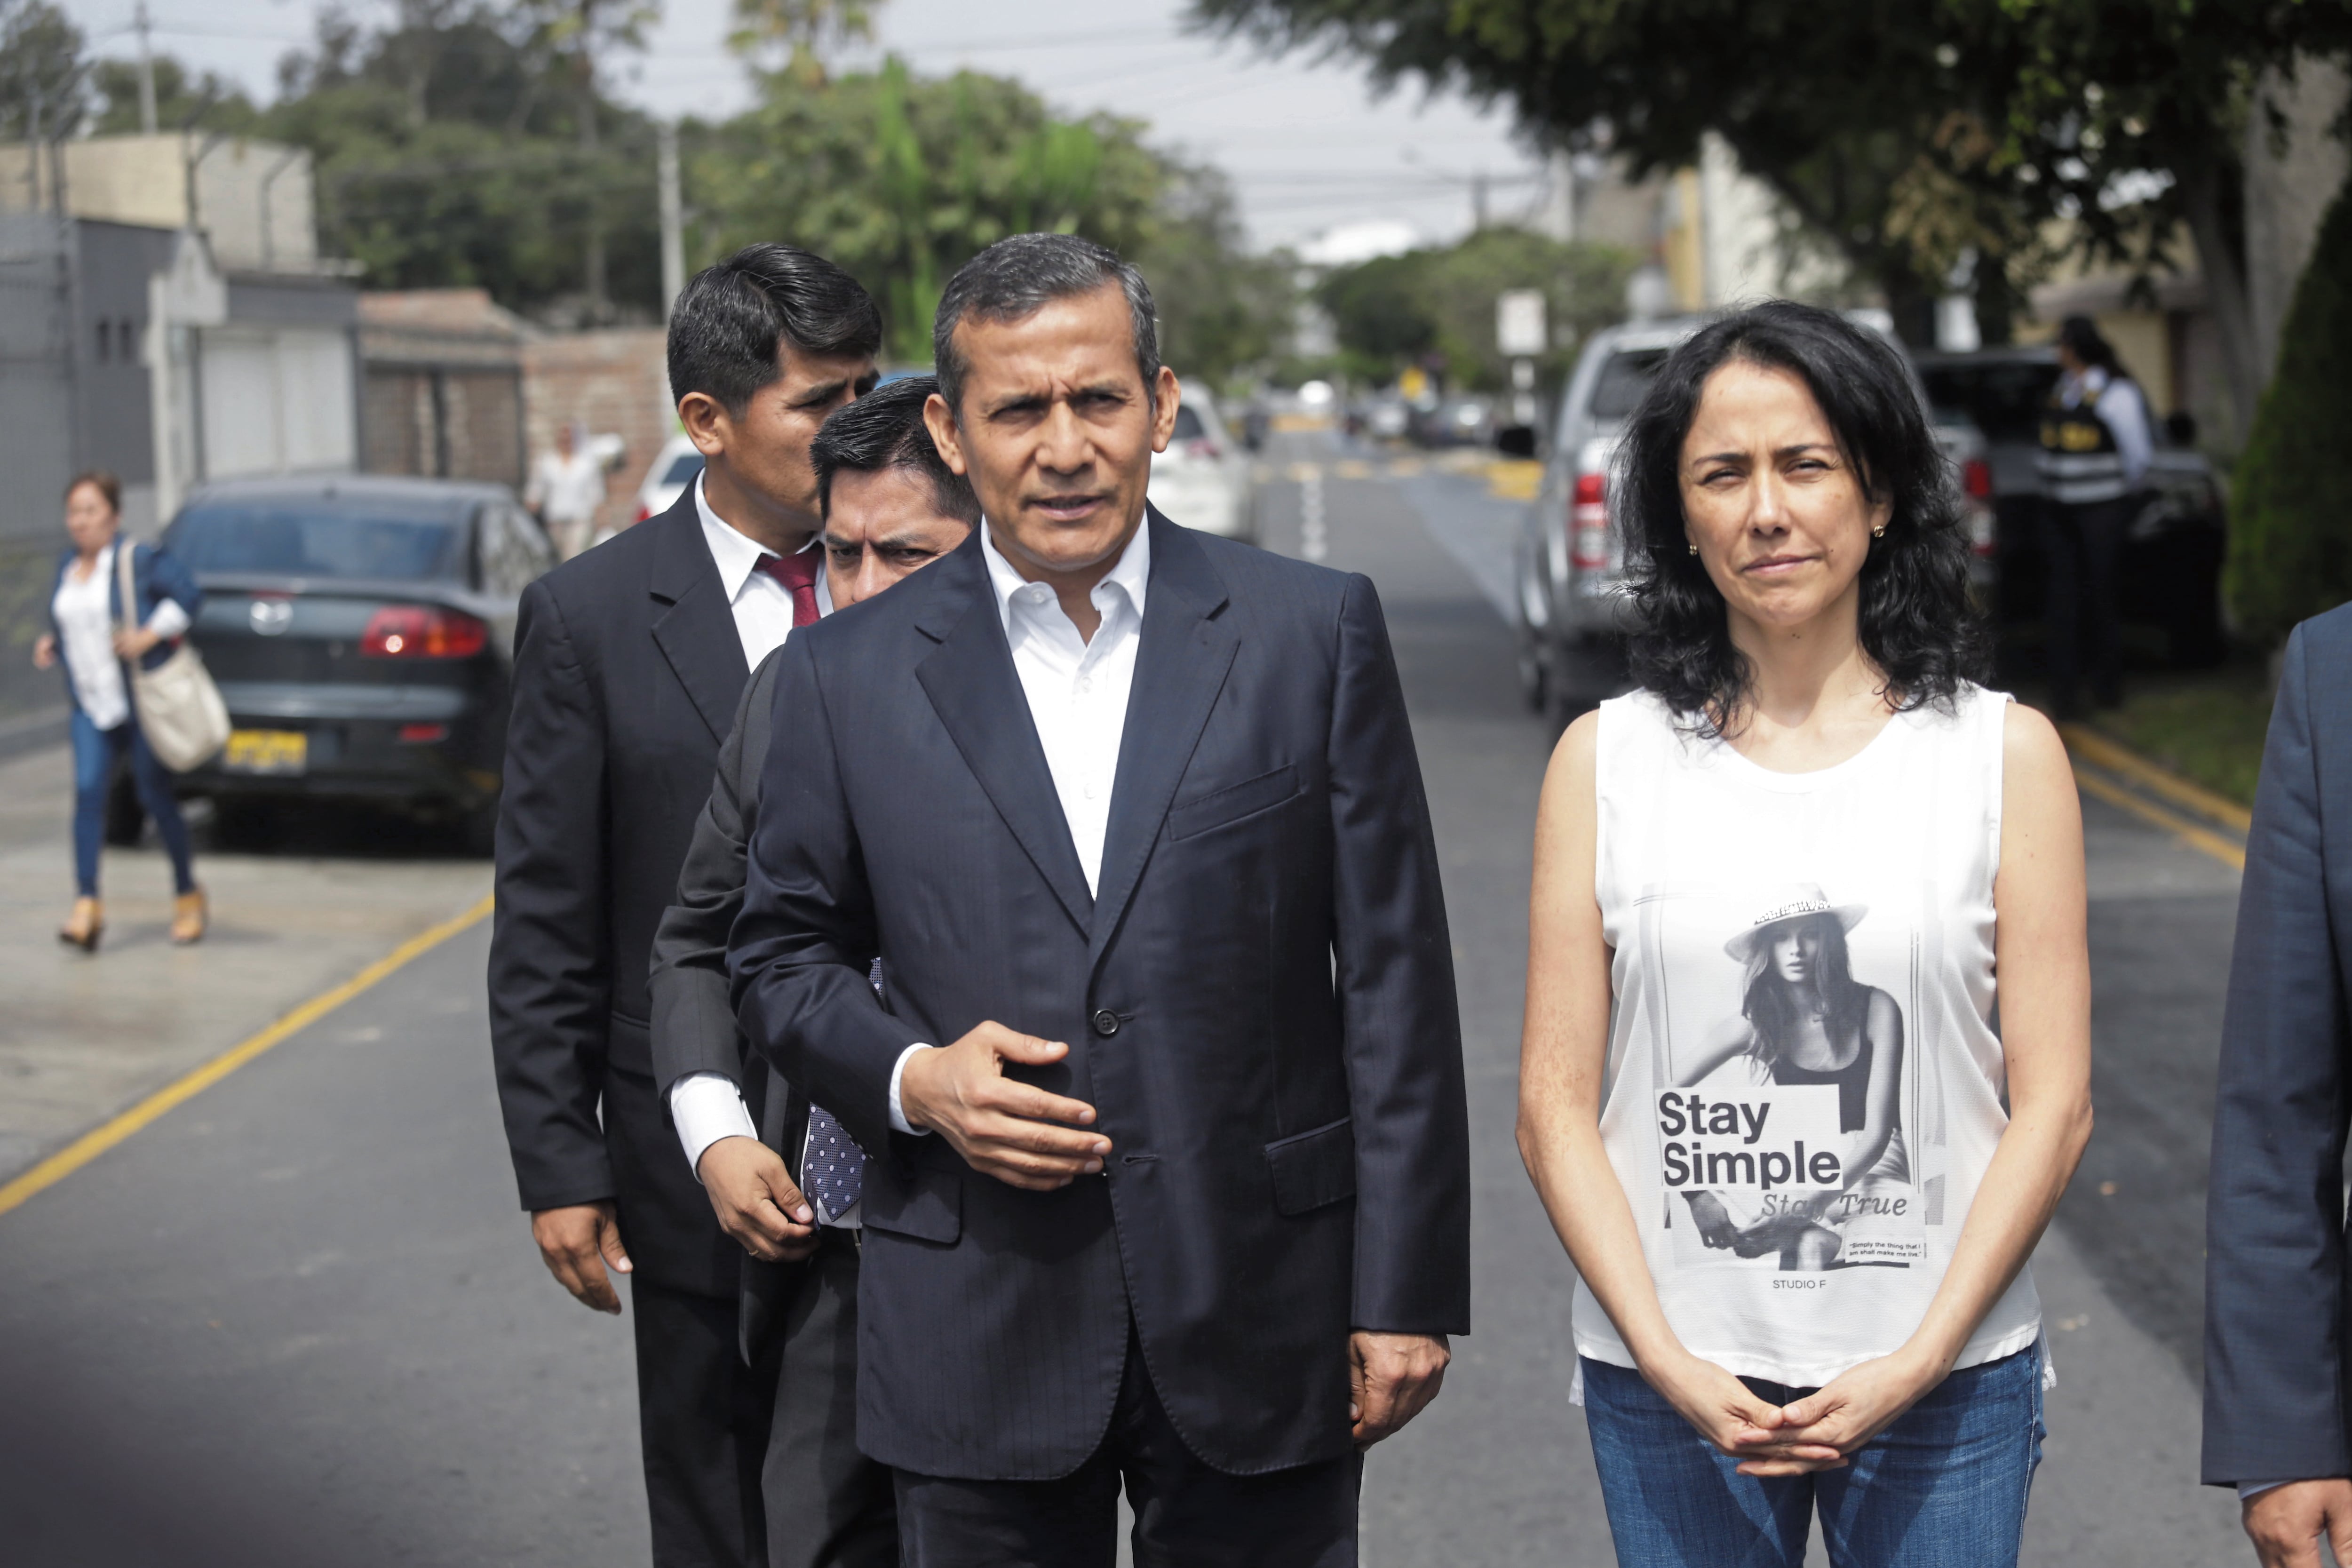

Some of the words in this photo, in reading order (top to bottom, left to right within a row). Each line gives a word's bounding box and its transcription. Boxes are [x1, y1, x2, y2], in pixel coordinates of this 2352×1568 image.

[1659, 1091, 1771, 1144] Stay
[1664, 1140, 1840, 1190] Simple
[1761, 1194, 1826, 1223] Stay
[1840, 1194, 1907, 1216] True
[1773, 1280, 1815, 1289] STUDIO
[1820, 1280, 1826, 1288] F
